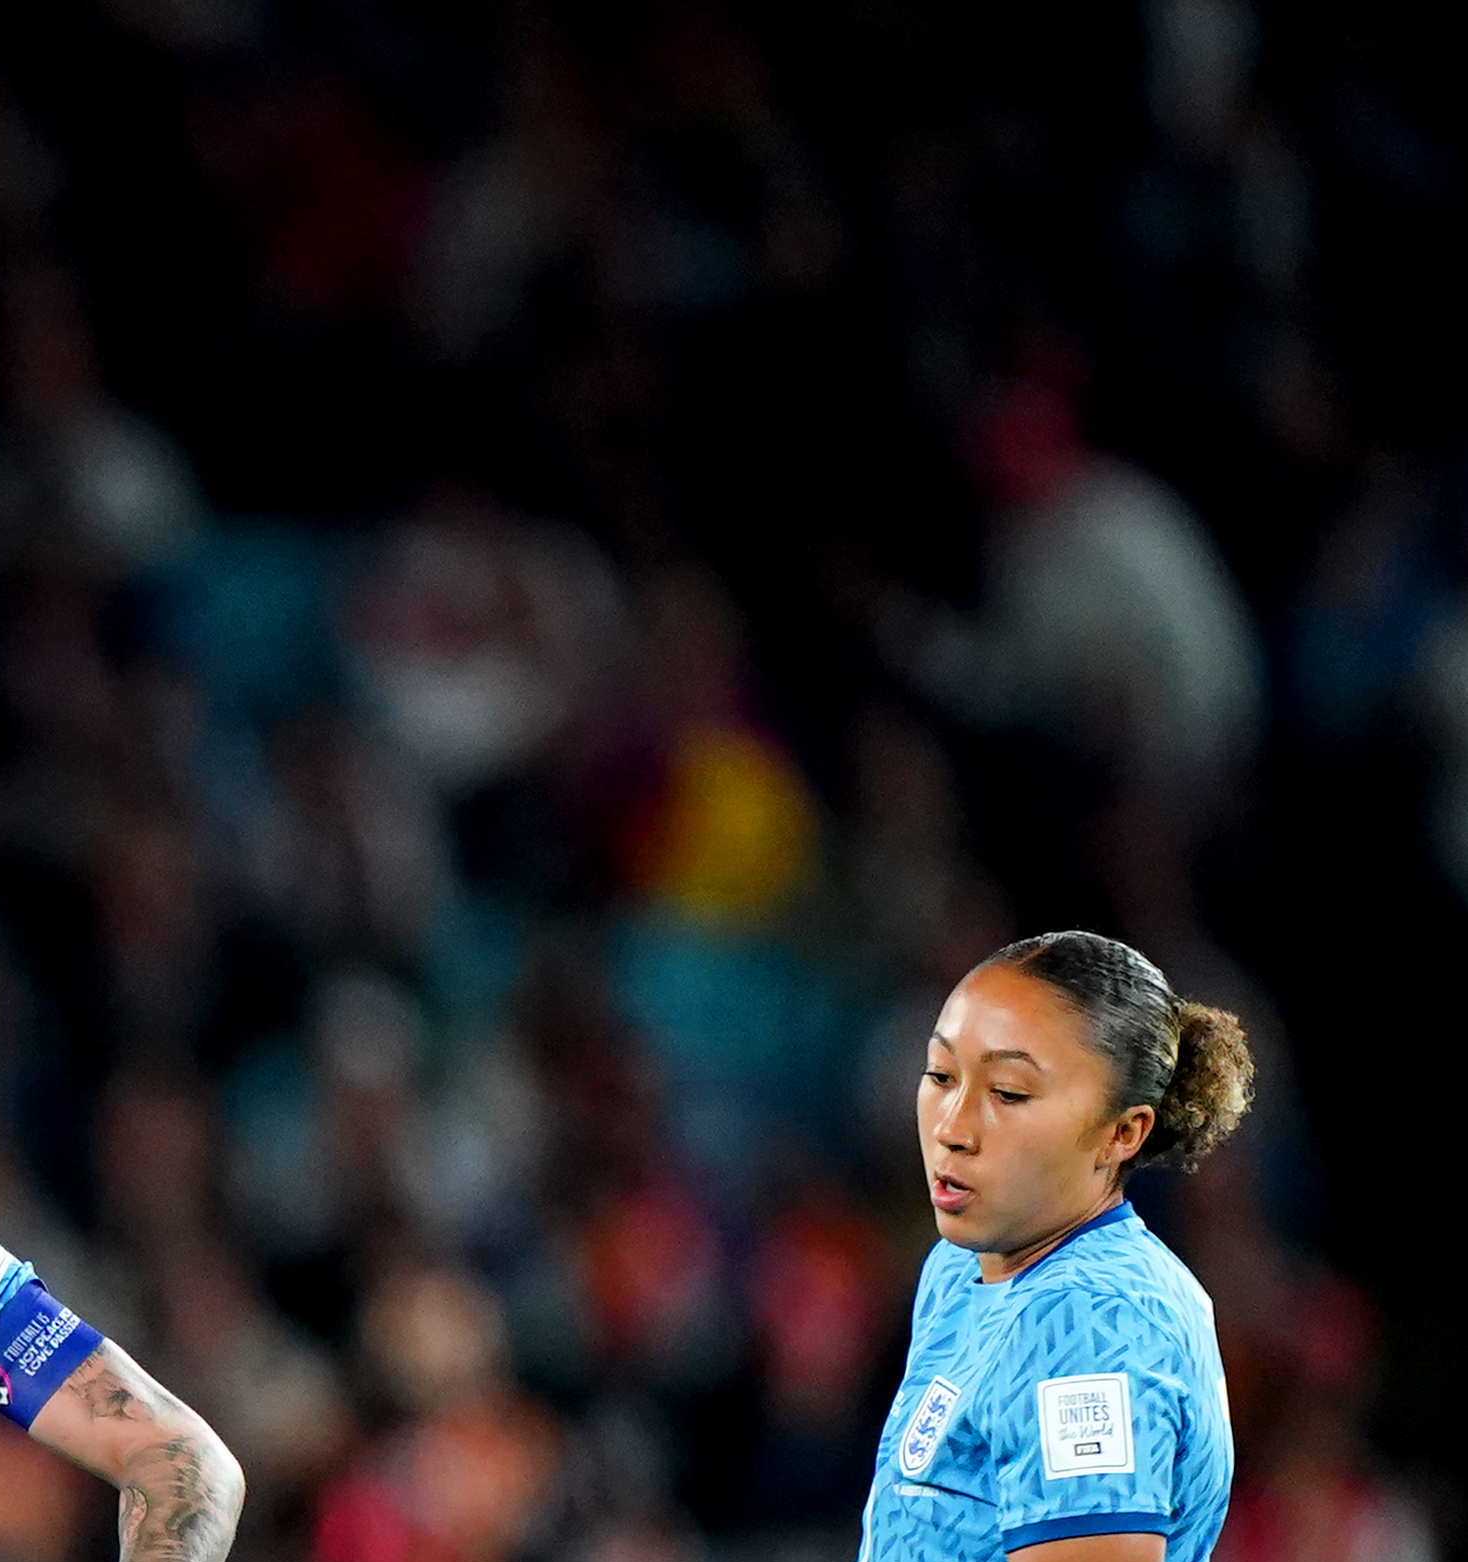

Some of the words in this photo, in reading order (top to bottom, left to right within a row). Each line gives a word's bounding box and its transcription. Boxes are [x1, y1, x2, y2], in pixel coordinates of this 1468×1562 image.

[3, 1319, 44, 1362] FOOTBALL
[36, 1311, 51, 1325] IS
[18, 1345, 39, 1370] JOY
[35, 1316, 65, 1348] PEACE
[24, 1345, 54, 1376] LOVE
[49, 1313, 81, 1349] PASSIO
[1058, 1391, 1109, 1408] FOOTBALL
[1059, 1405, 1110, 1425] UNITES
[1079, 1422, 1114, 1440] World
